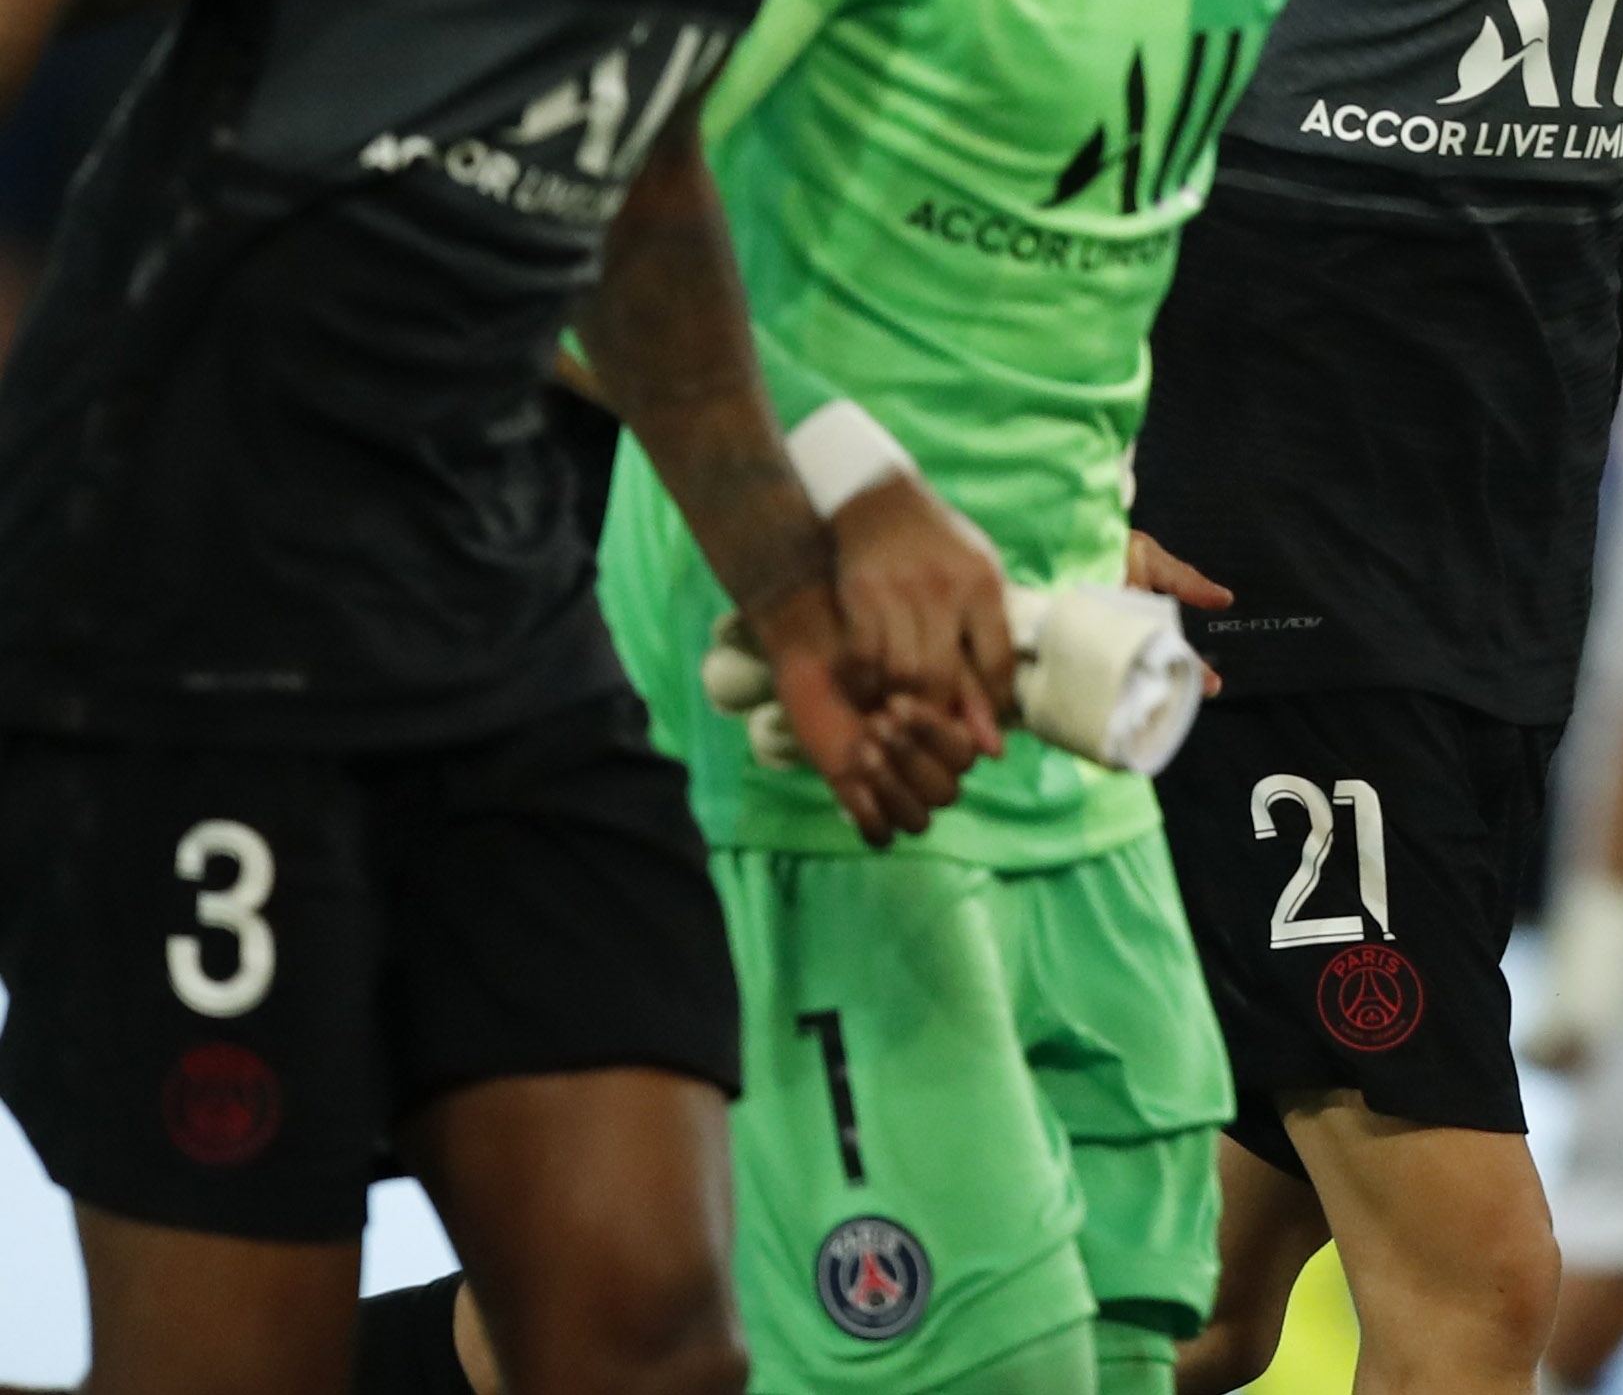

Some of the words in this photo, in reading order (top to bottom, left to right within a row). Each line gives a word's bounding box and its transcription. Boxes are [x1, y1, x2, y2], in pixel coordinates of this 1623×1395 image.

[1299, 99, 1467, 156] ACCOR
[1473, 122, 1560, 159] LIVE
[904, 200, 1071, 267] ACCOR
[166, 820, 275, 1017] 3
[1250, 773, 1396, 949] 21
[1332, 949, 1400, 978] PARIS
[793, 1008, 866, 1186] 1
